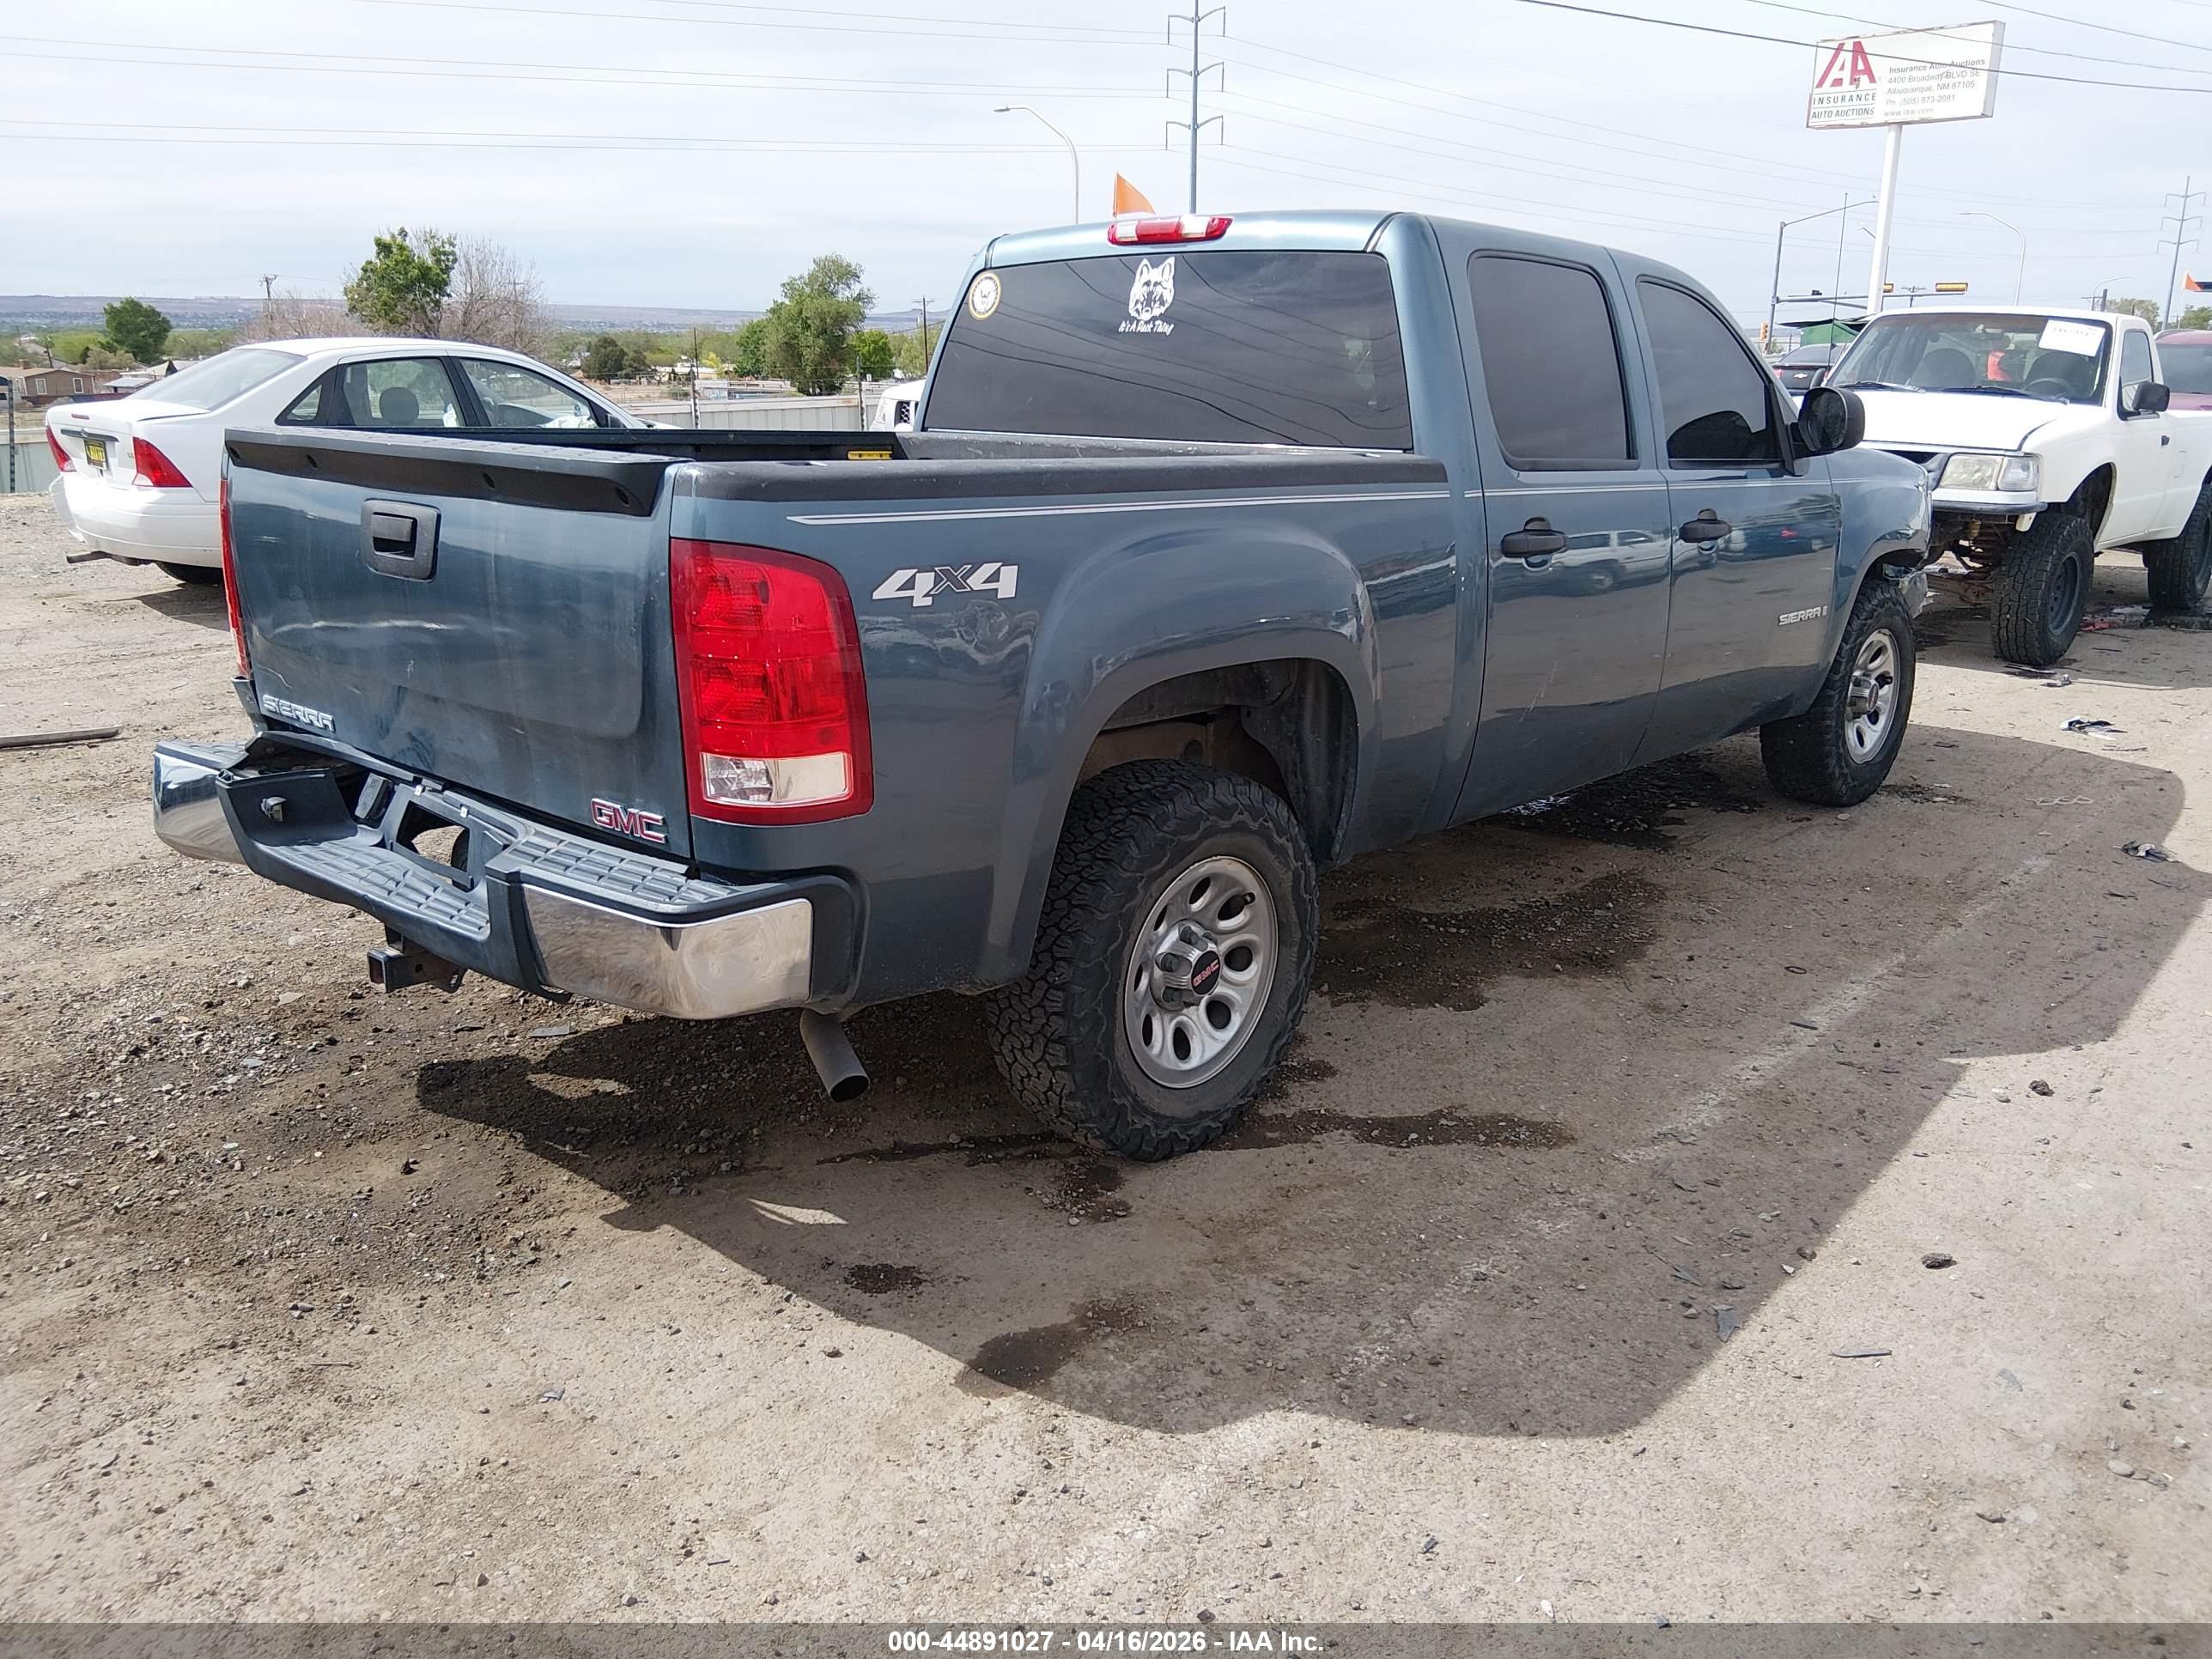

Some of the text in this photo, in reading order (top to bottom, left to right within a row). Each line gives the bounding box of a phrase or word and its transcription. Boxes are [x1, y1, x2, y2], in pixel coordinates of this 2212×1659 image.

[1889, 64, 1927, 74] Insurance
[1948, 58, 1985, 68] Auctions
[1887, 69, 1980, 84] 4400 Broadway BLVD SE
[1936, 82, 1950, 91] NM
[1951, 81, 1975, 89] 87105
[1813, 92, 1876, 106] INSURANCE
[1812, 106, 1875, 119] AUTO AUCTIONS
[1778, 606, 1821, 626] SIERRA
[262, 694, 337, 733] SIERRA
[591, 798, 667, 844] GMC
[1193, 959, 1219, 987] GMC
